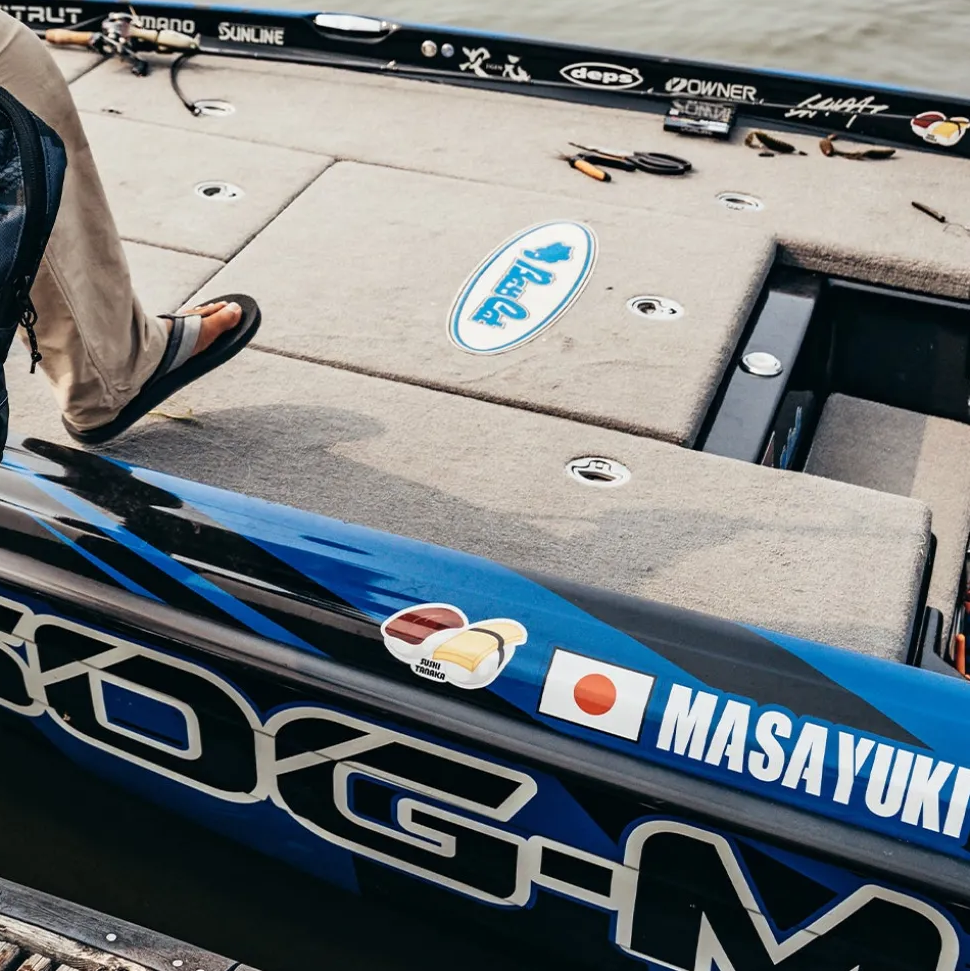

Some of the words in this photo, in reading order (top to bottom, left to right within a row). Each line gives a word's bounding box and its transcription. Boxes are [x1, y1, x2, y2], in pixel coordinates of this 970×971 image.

[138, 15, 196, 34] MANO
[218, 22, 284, 46] SUNLINE
[570, 67, 633, 84] deps
[687, 78, 757, 101] OWNER
[414, 664, 446, 681] TANAKA
[420, 658, 442, 670] SUSHI
[656, 683, 970, 838] MASAYUKI
